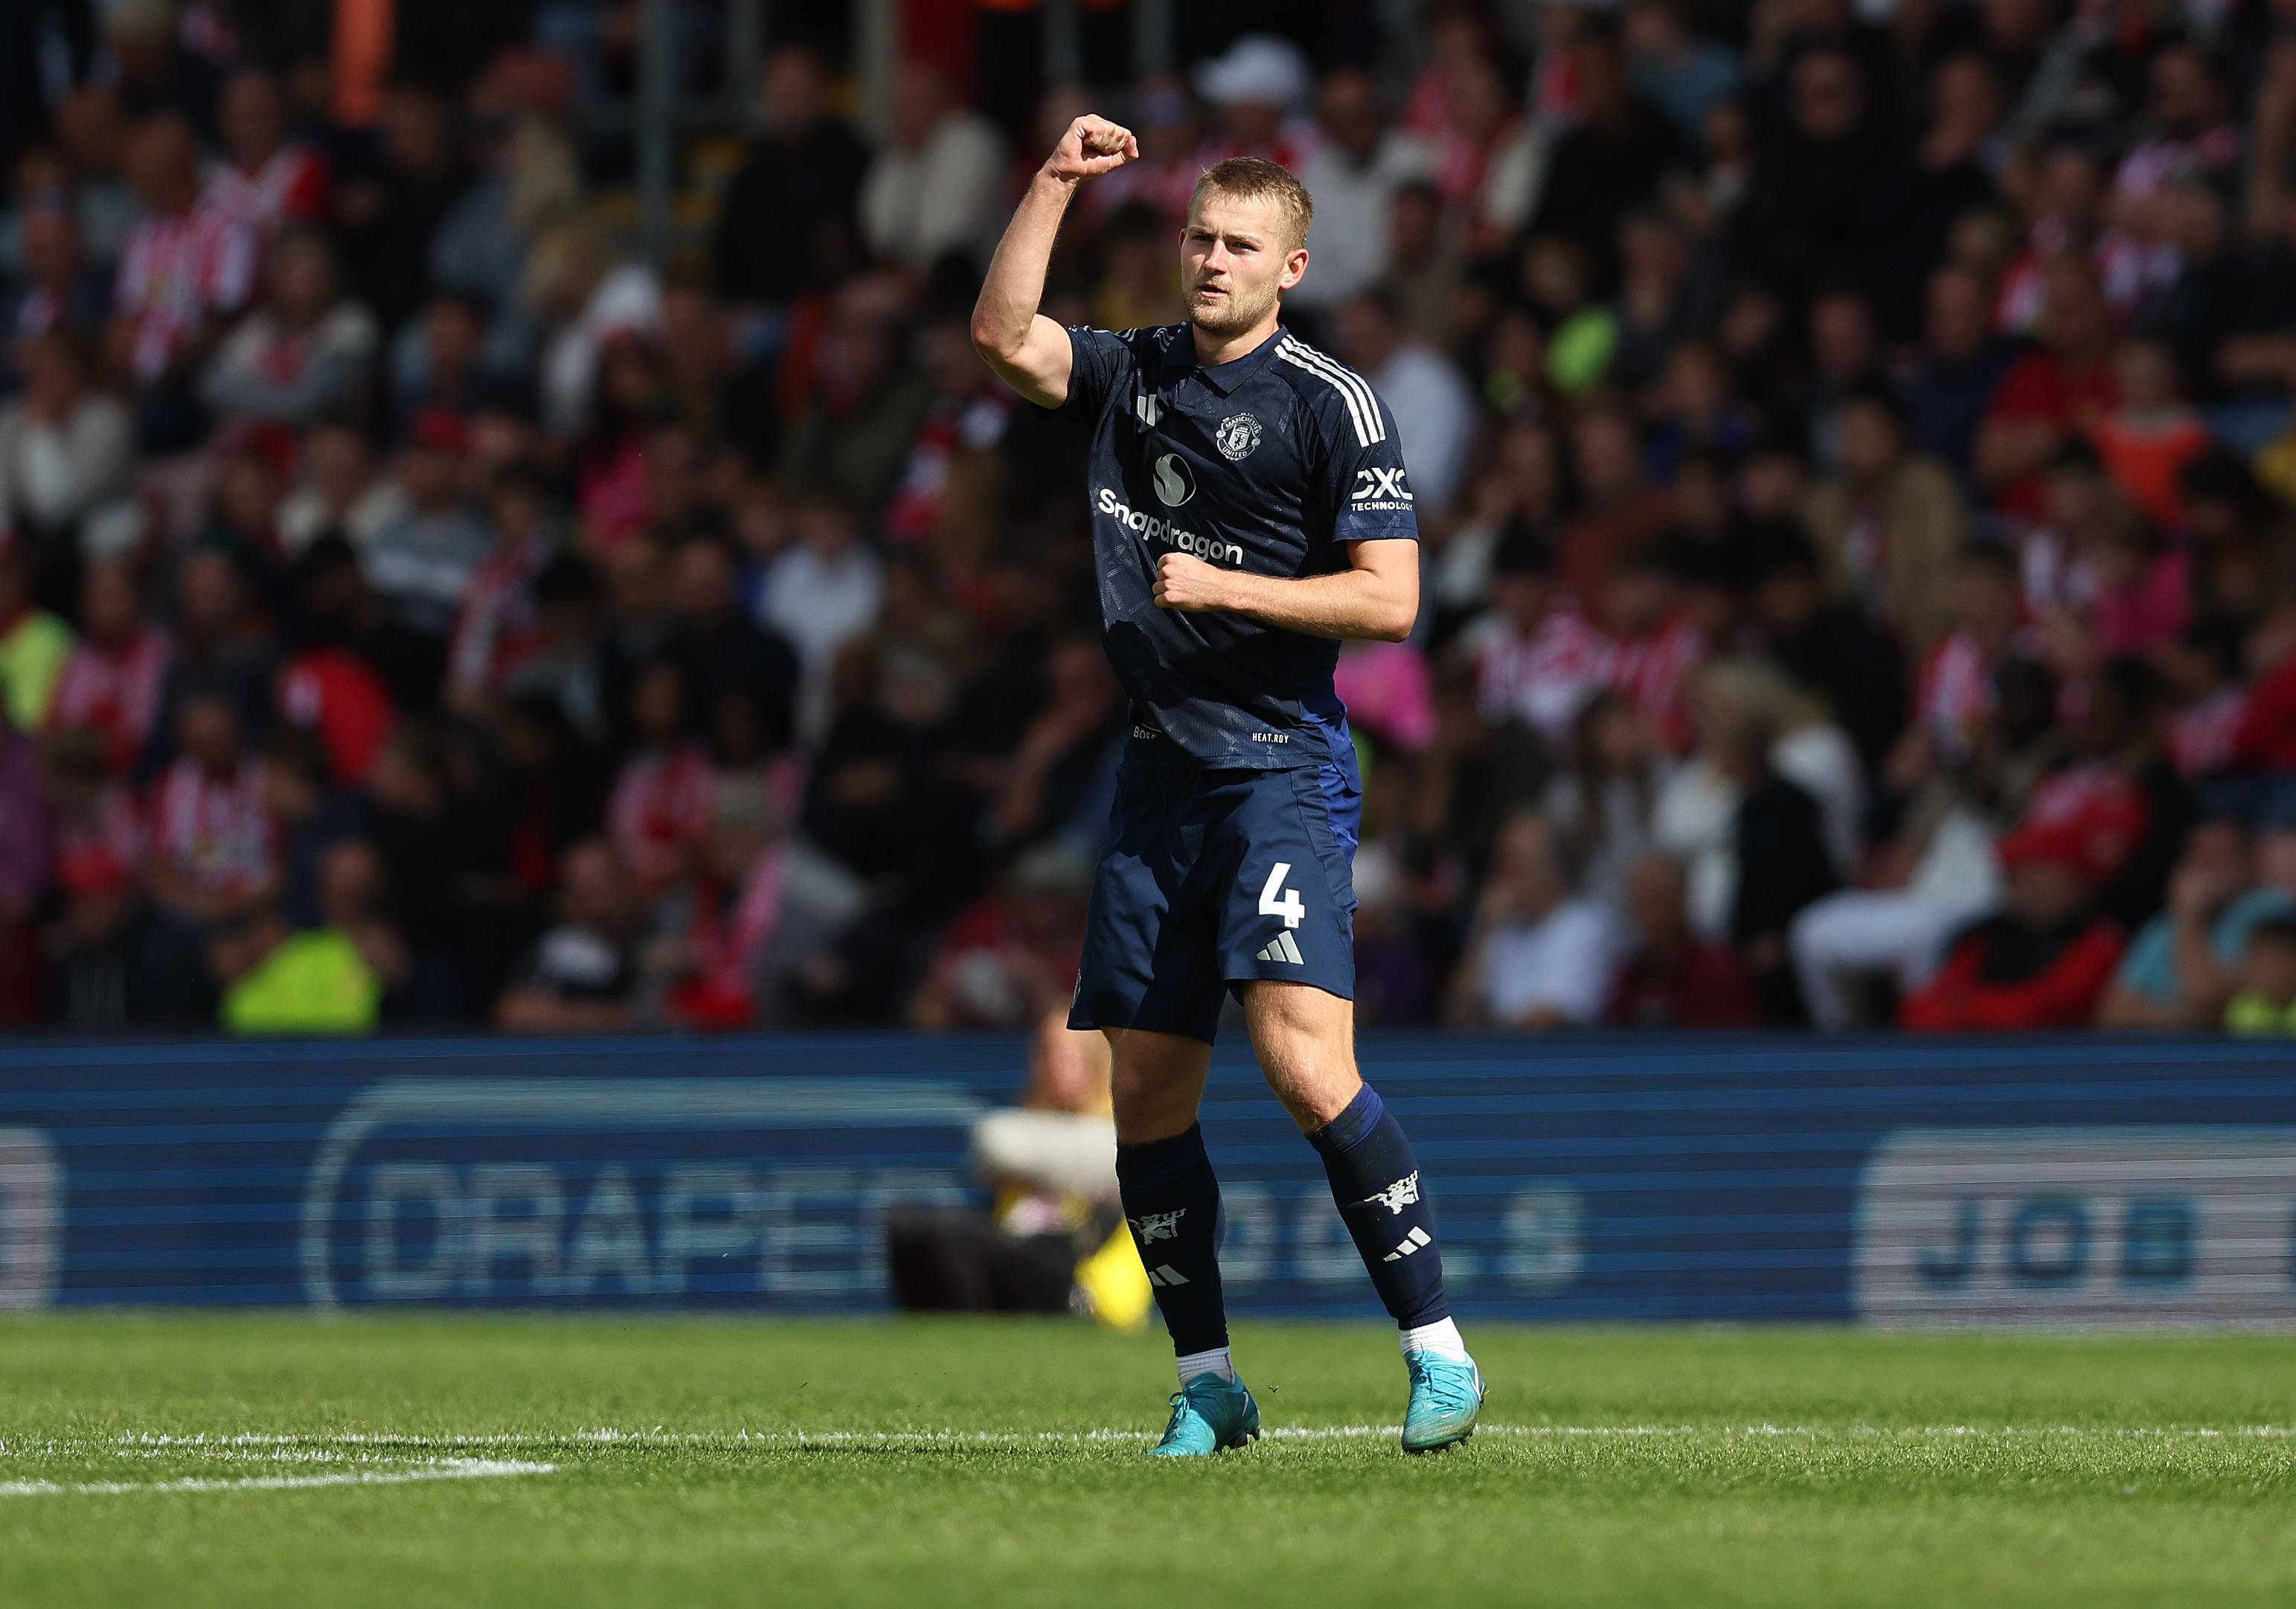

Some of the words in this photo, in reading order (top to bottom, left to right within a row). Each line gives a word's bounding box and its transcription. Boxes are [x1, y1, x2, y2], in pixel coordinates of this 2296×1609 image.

[1225, 417, 1260, 434] MANCHESTER
[1222, 446, 1247, 457] UNITED
[1351, 467, 1414, 501] DXC
[1350, 501, 1413, 512] TECHNOLOGY
[1097, 488, 1244, 565] Snapdragon
[1252, 732, 1289, 744] HEAT.RDY
[1258, 862, 1306, 928] 4
[1914, 1193, 2199, 1294] JOB
